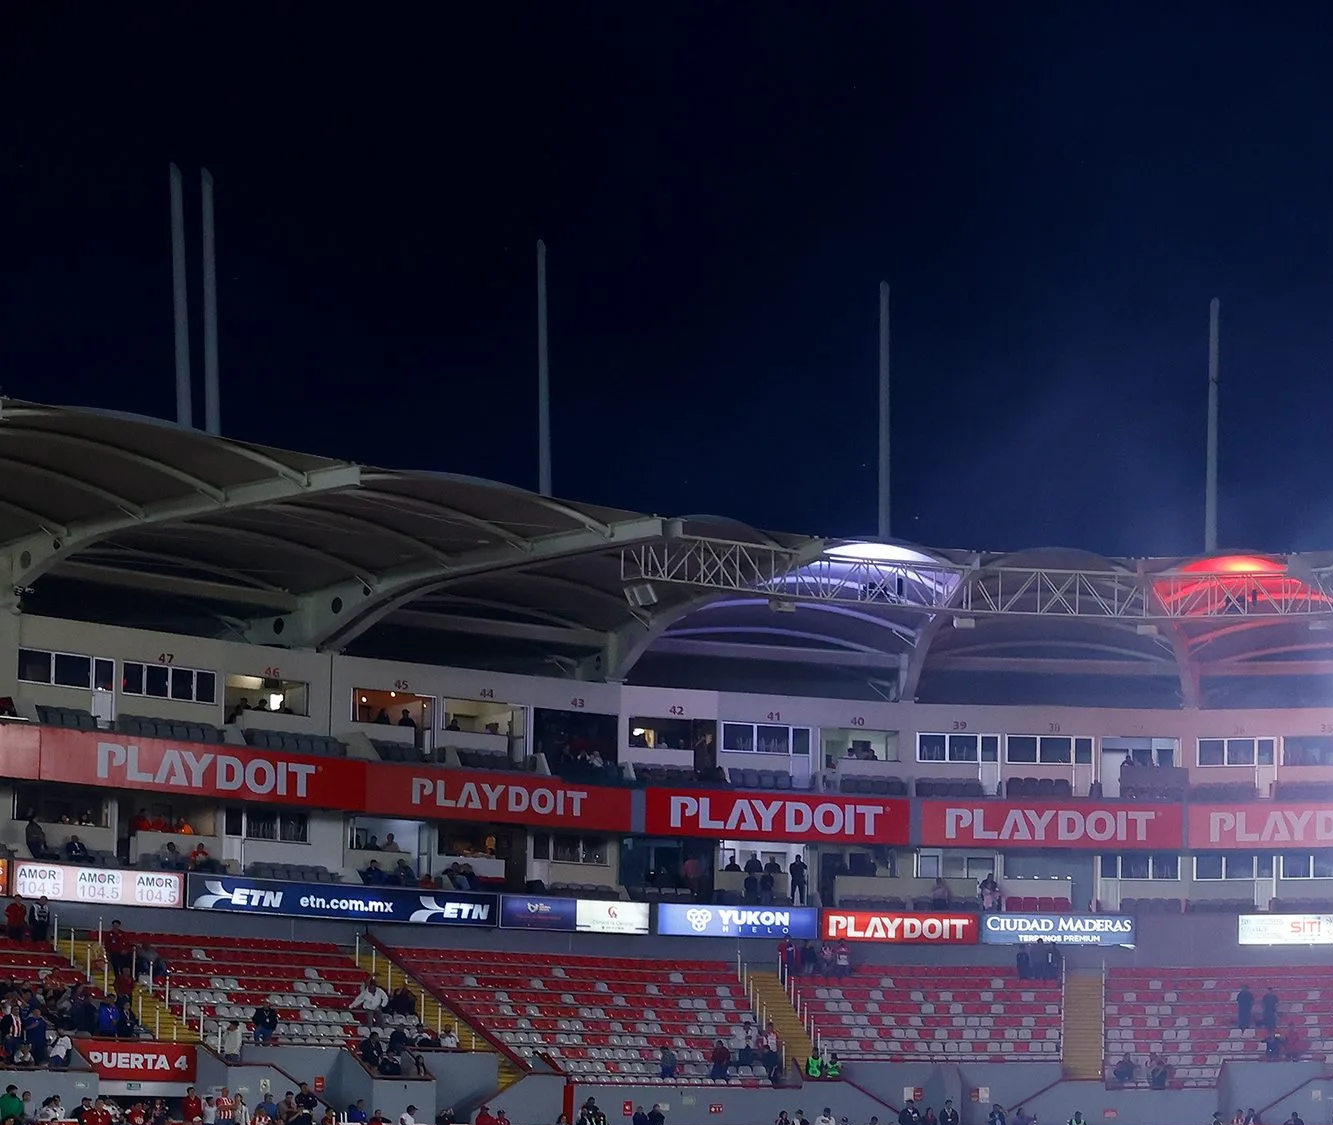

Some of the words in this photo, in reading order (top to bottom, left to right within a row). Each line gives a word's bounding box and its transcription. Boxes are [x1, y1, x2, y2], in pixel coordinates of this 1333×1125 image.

[158, 652, 174, 664] 47
[264, 666, 280, 678] 46
[394, 679, 409, 691] 45
[479, 688, 494, 699] 44
[570, 697, 585, 709] 43
[669, 704, 685, 716] 42
[766, 710, 781, 722] 41
[850, 715, 865, 727] 40
[952, 721, 968, 731] 39
[97, 741, 316, 799] PLAYDOIT
[411, 777, 587, 818] PLAYDOIT
[670, 795, 884, 837] PLAYDOIT
[944, 807, 1155, 842] PLAYDOIT
[18, 867, 57, 880] AMOR
[78, 871, 116, 885] AMOR
[18, 881, 61, 896] 104.5
[136, 876, 173, 889] AMOR
[79, 885, 120, 900] 104.5
[138, 889, 177, 903] 104.5
[230, 886, 284, 910] ETN
[299, 893, 394, 916] etn.com.mx
[442, 901, 489, 921] ETN
[718, 910, 790, 926] YUKON
[986, 916, 1055, 931] CIUDAD
[1057, 917, 1132, 932] MADERAS
[722, 926, 790, 934] HIELO
[828, 915, 970, 940] PLAYDOIT
[175, 1055, 188, 1071] 4
